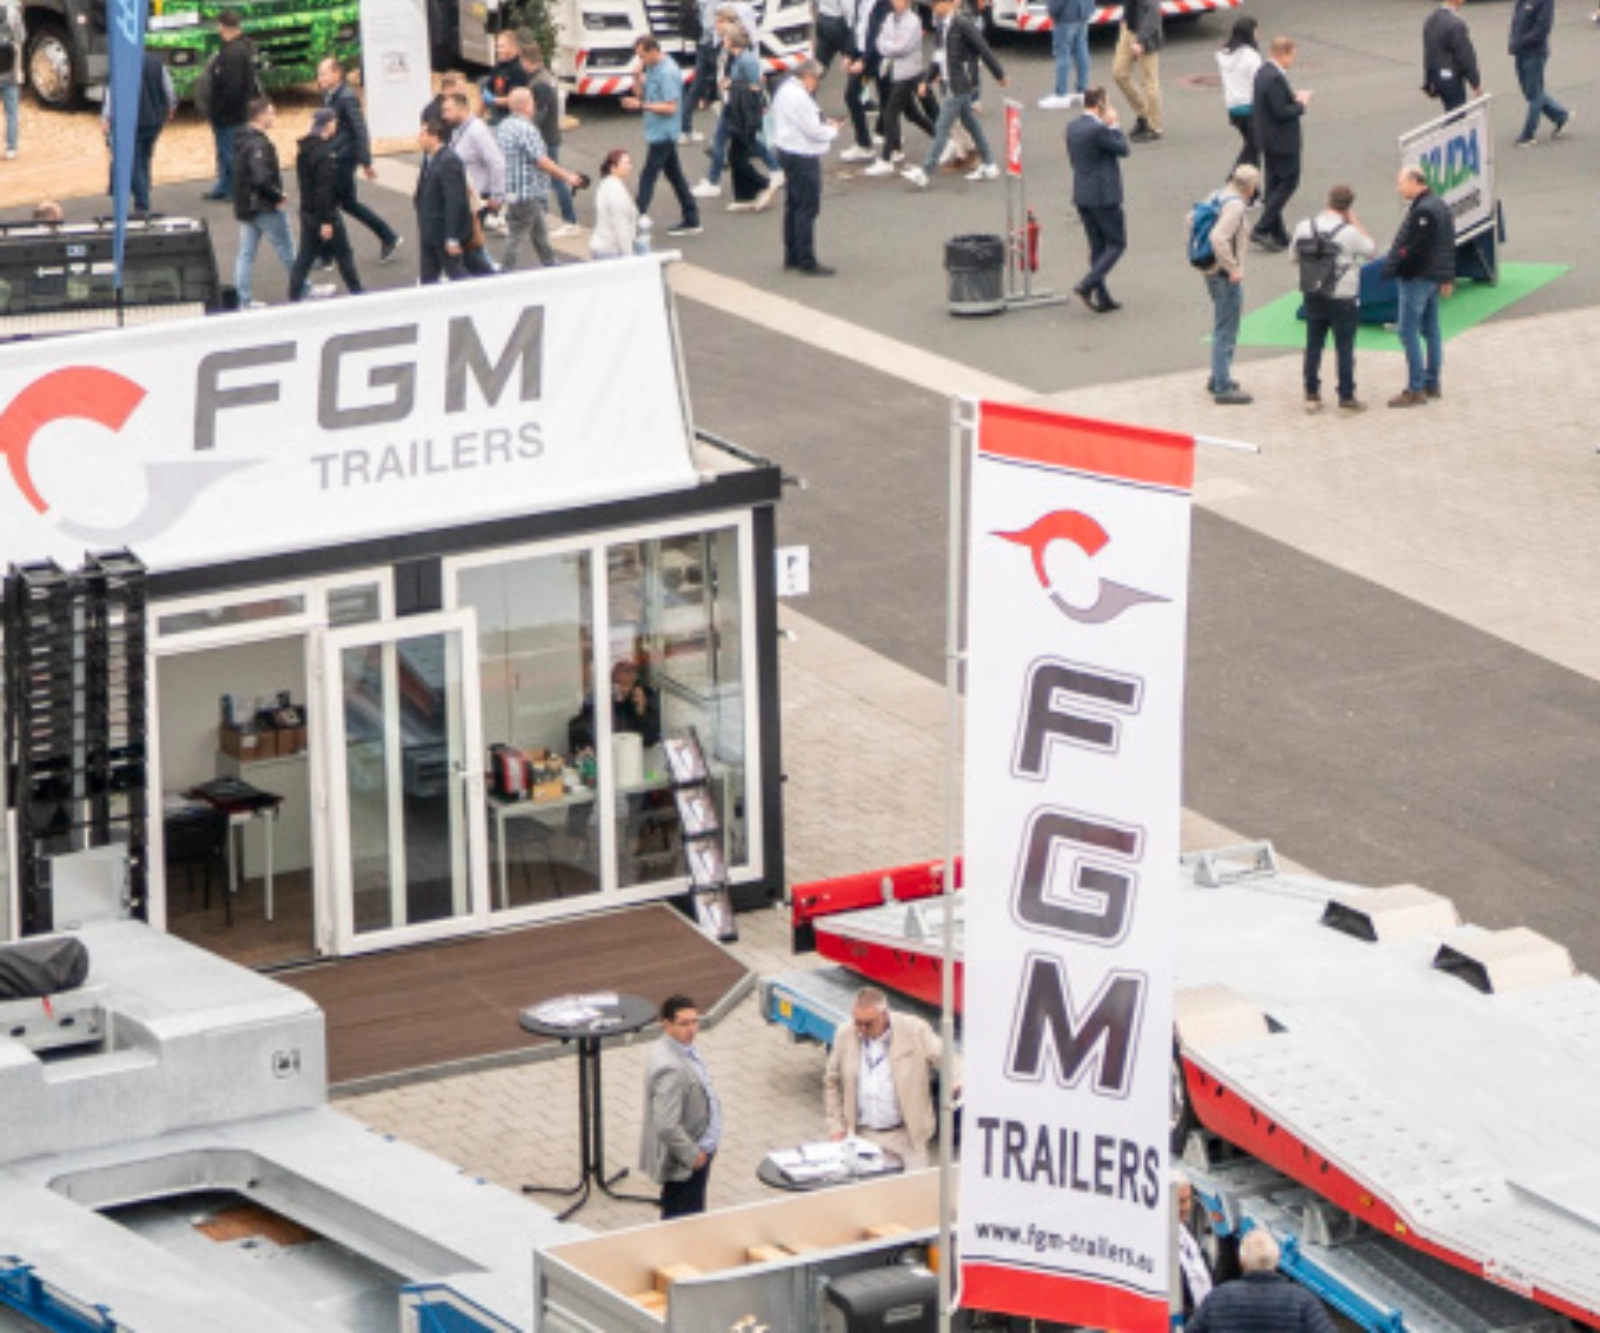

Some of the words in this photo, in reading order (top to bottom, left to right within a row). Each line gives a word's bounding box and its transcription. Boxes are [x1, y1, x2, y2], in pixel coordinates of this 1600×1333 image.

[193, 305, 546, 451] FGM
[311, 421, 546, 492] TRAILERS
[1005, 654, 1148, 1100] FGM
[977, 1117, 1160, 1211] TRAILERS
[975, 1223, 1155, 1274] www.fgm-trailers.eu
